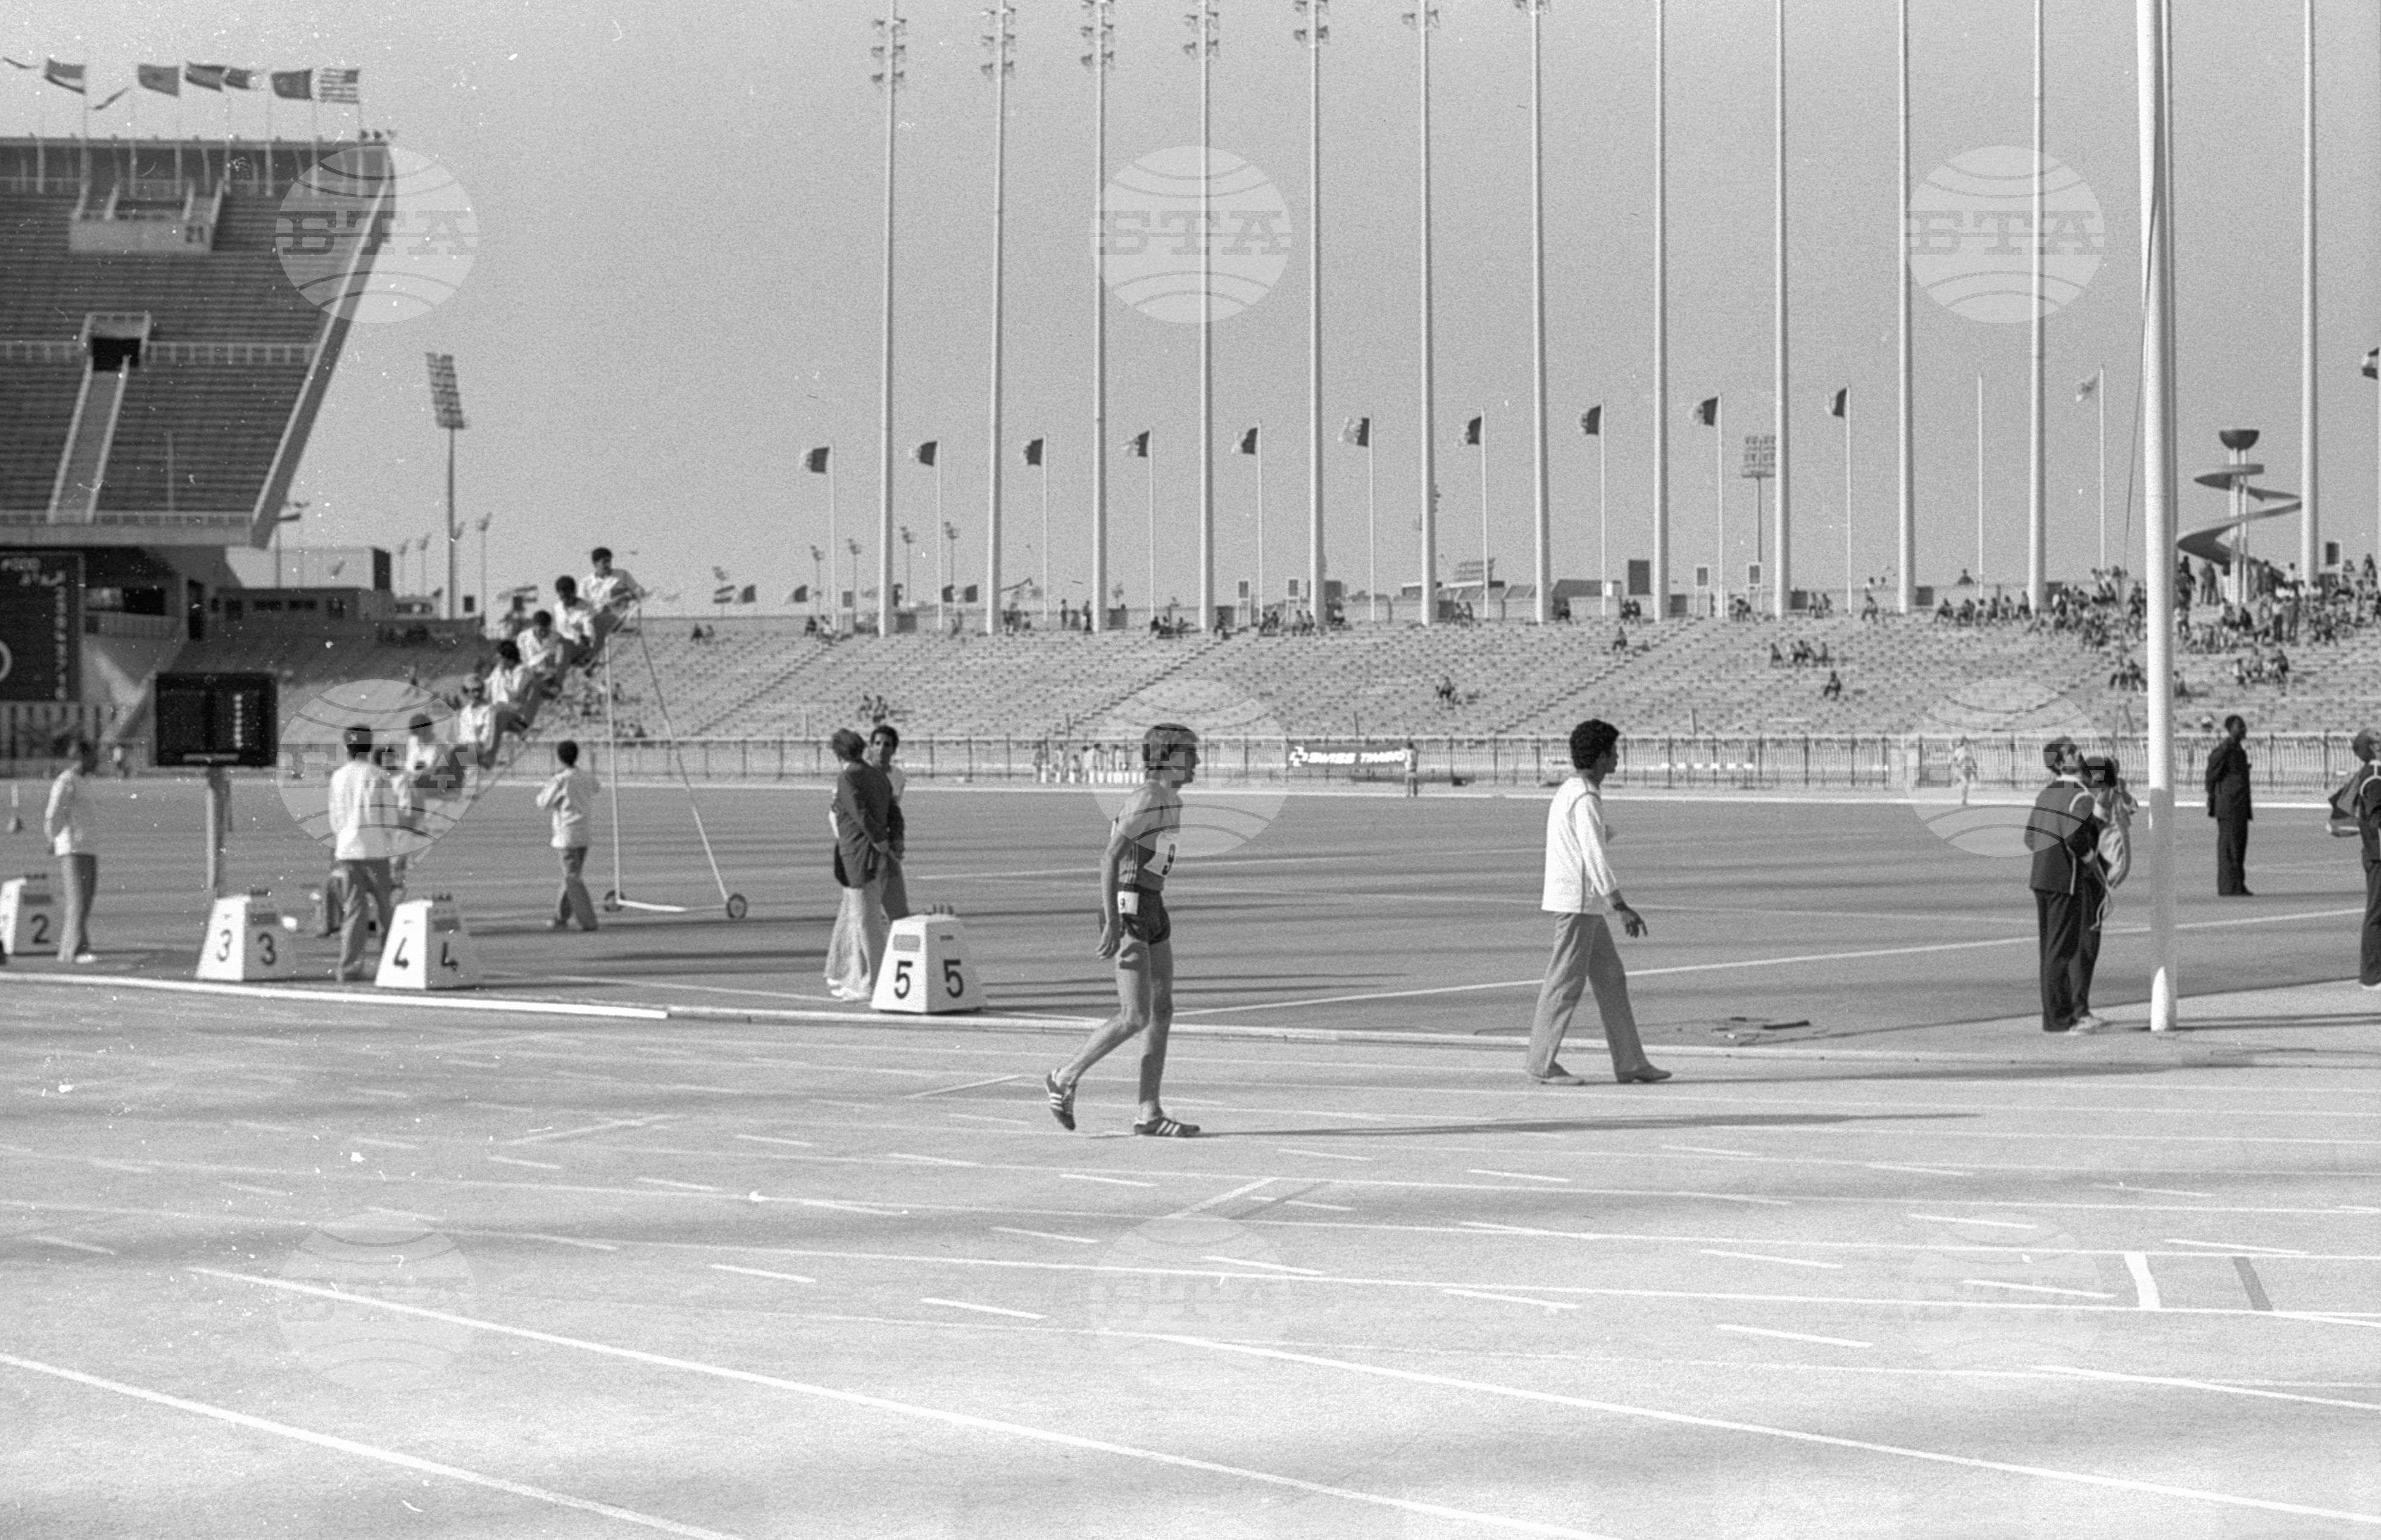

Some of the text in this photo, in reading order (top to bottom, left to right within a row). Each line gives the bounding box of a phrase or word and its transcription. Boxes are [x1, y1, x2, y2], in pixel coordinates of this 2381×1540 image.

[31, 914, 49, 944] 2
[216, 929, 232, 962] 3
[258, 932, 277, 966] 3
[393, 936, 409, 969] 4
[441, 941, 458, 972] 4
[894, 960, 913, 999] 5
[943, 958, 964, 998] 5
